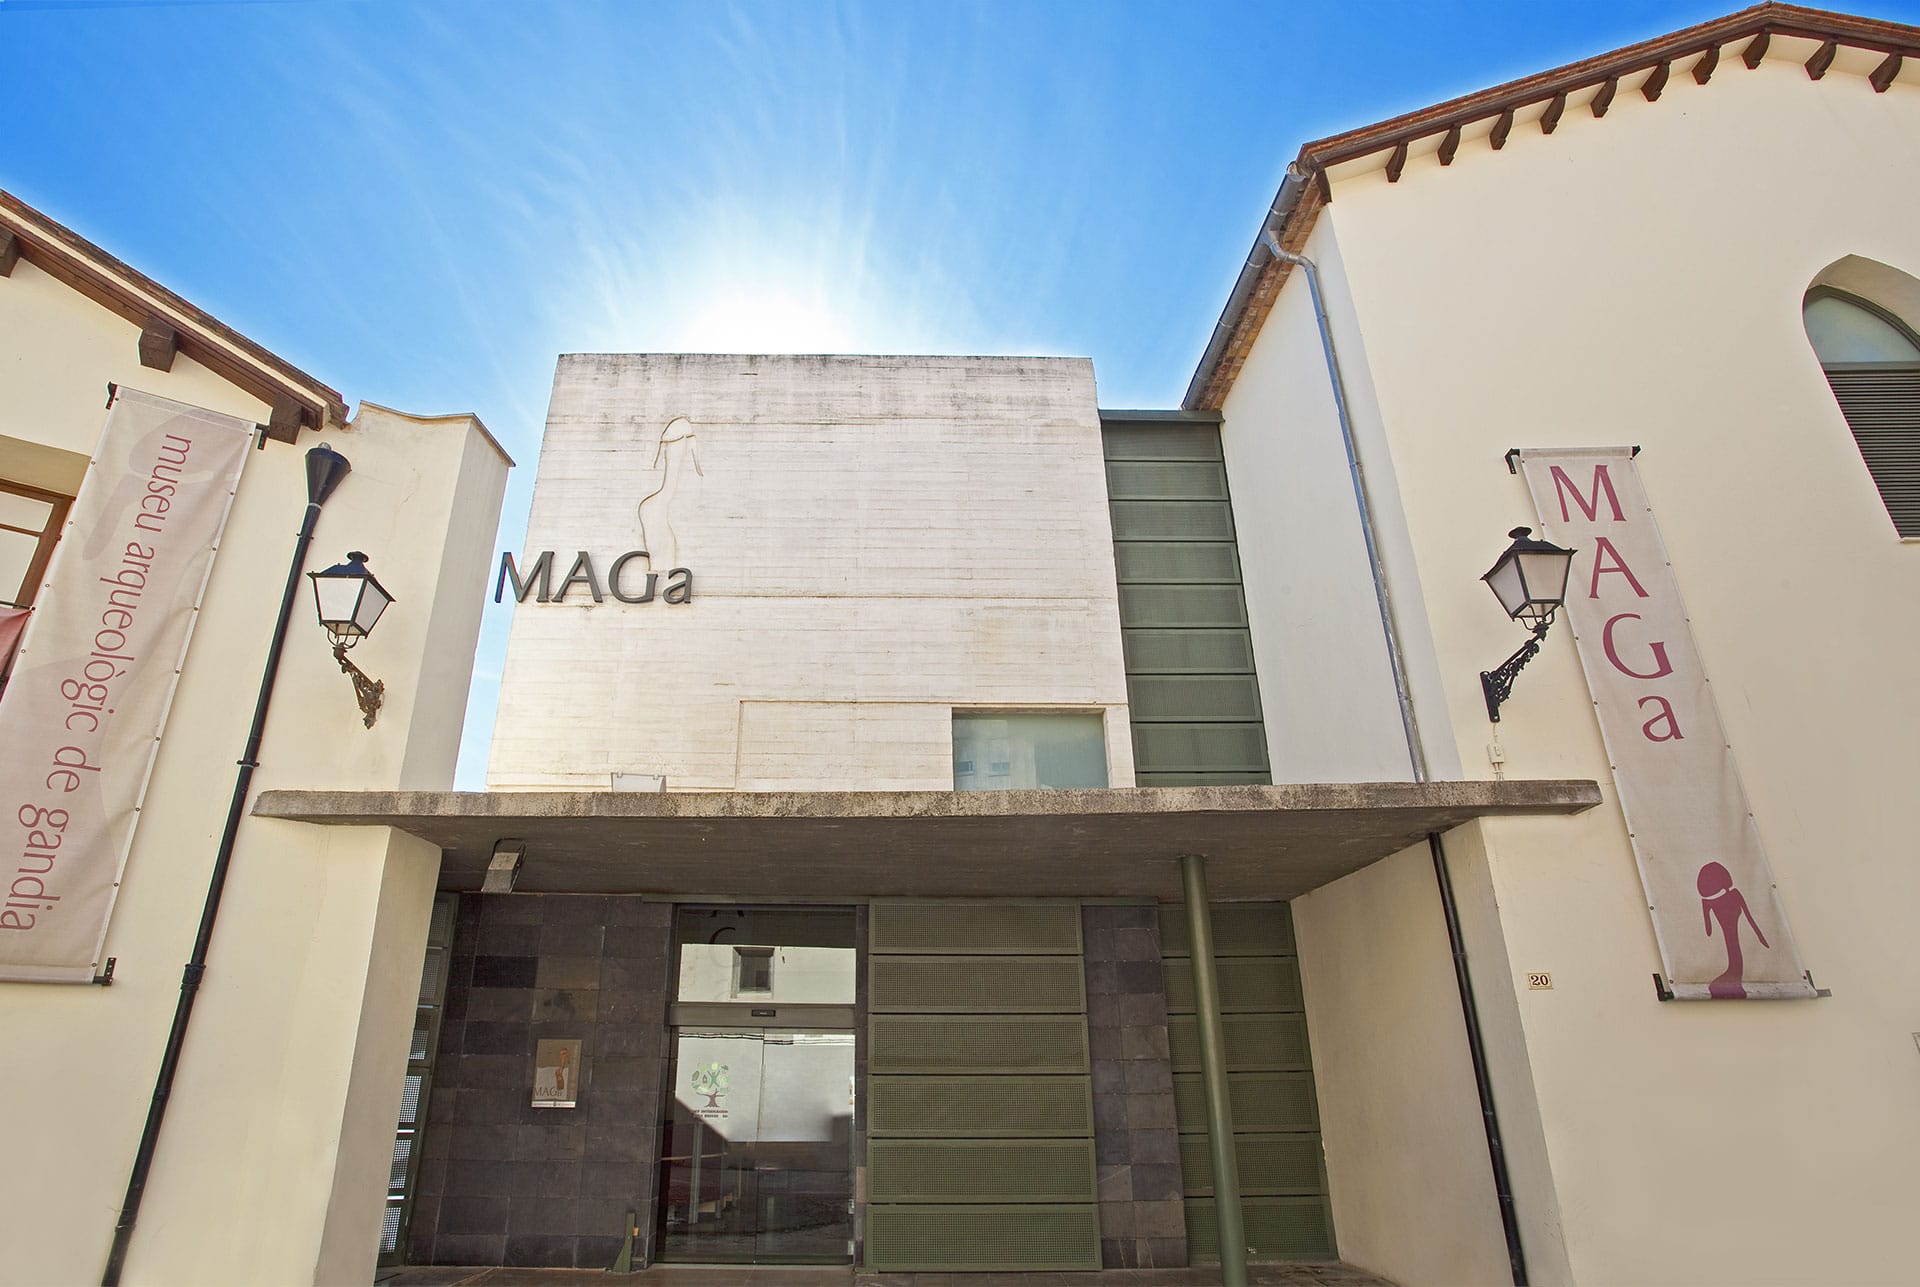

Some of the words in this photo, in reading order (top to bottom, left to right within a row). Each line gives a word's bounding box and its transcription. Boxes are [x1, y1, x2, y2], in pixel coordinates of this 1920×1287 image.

[134, 434, 192, 533] museu
[494, 550, 693, 605] MAGa
[60, 541, 155, 733] arqueològic
[46, 746, 102, 793] de
[0, 803, 70, 931] gandia
[1530, 974, 1549, 986] 20
